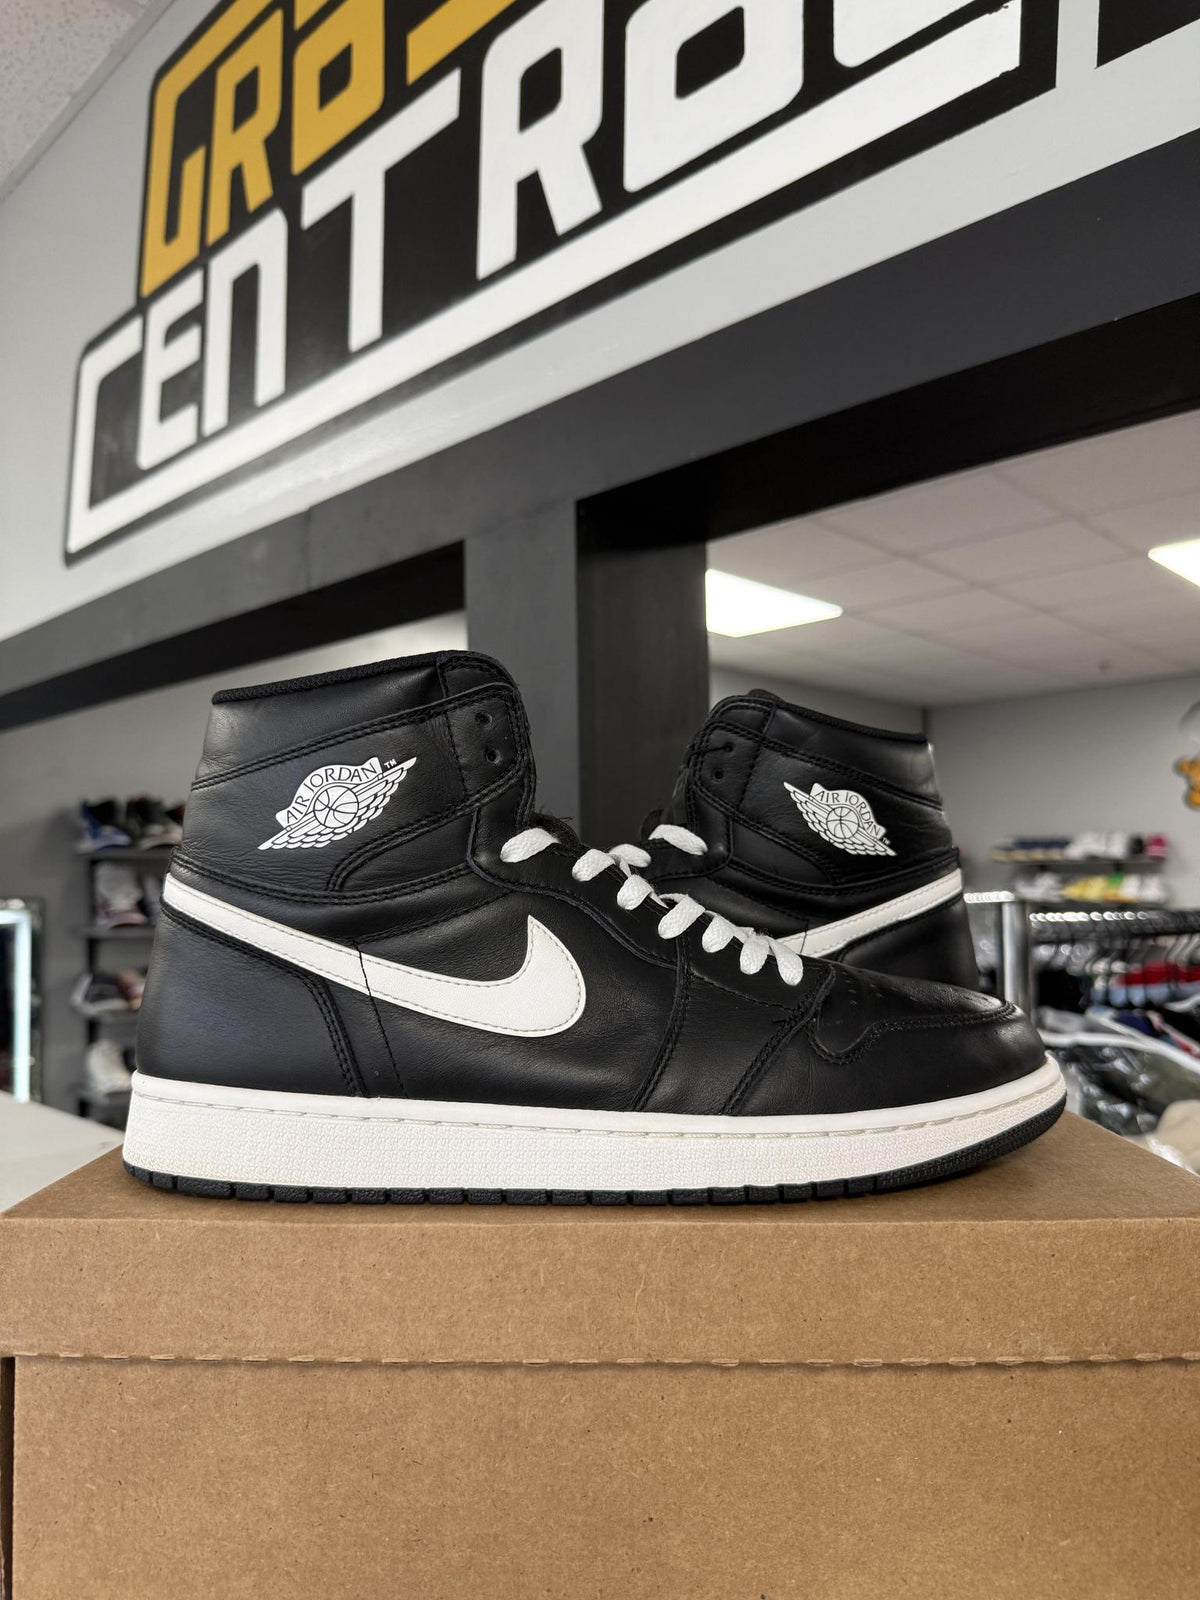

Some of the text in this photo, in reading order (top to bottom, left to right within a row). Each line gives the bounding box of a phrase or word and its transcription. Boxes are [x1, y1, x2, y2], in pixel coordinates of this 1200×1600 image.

[286, 795, 310, 824] AIR
[304, 762, 377, 793] JORDAN
[814, 790, 840, 803] AIR
[845, 791, 881, 837] JORDAN
